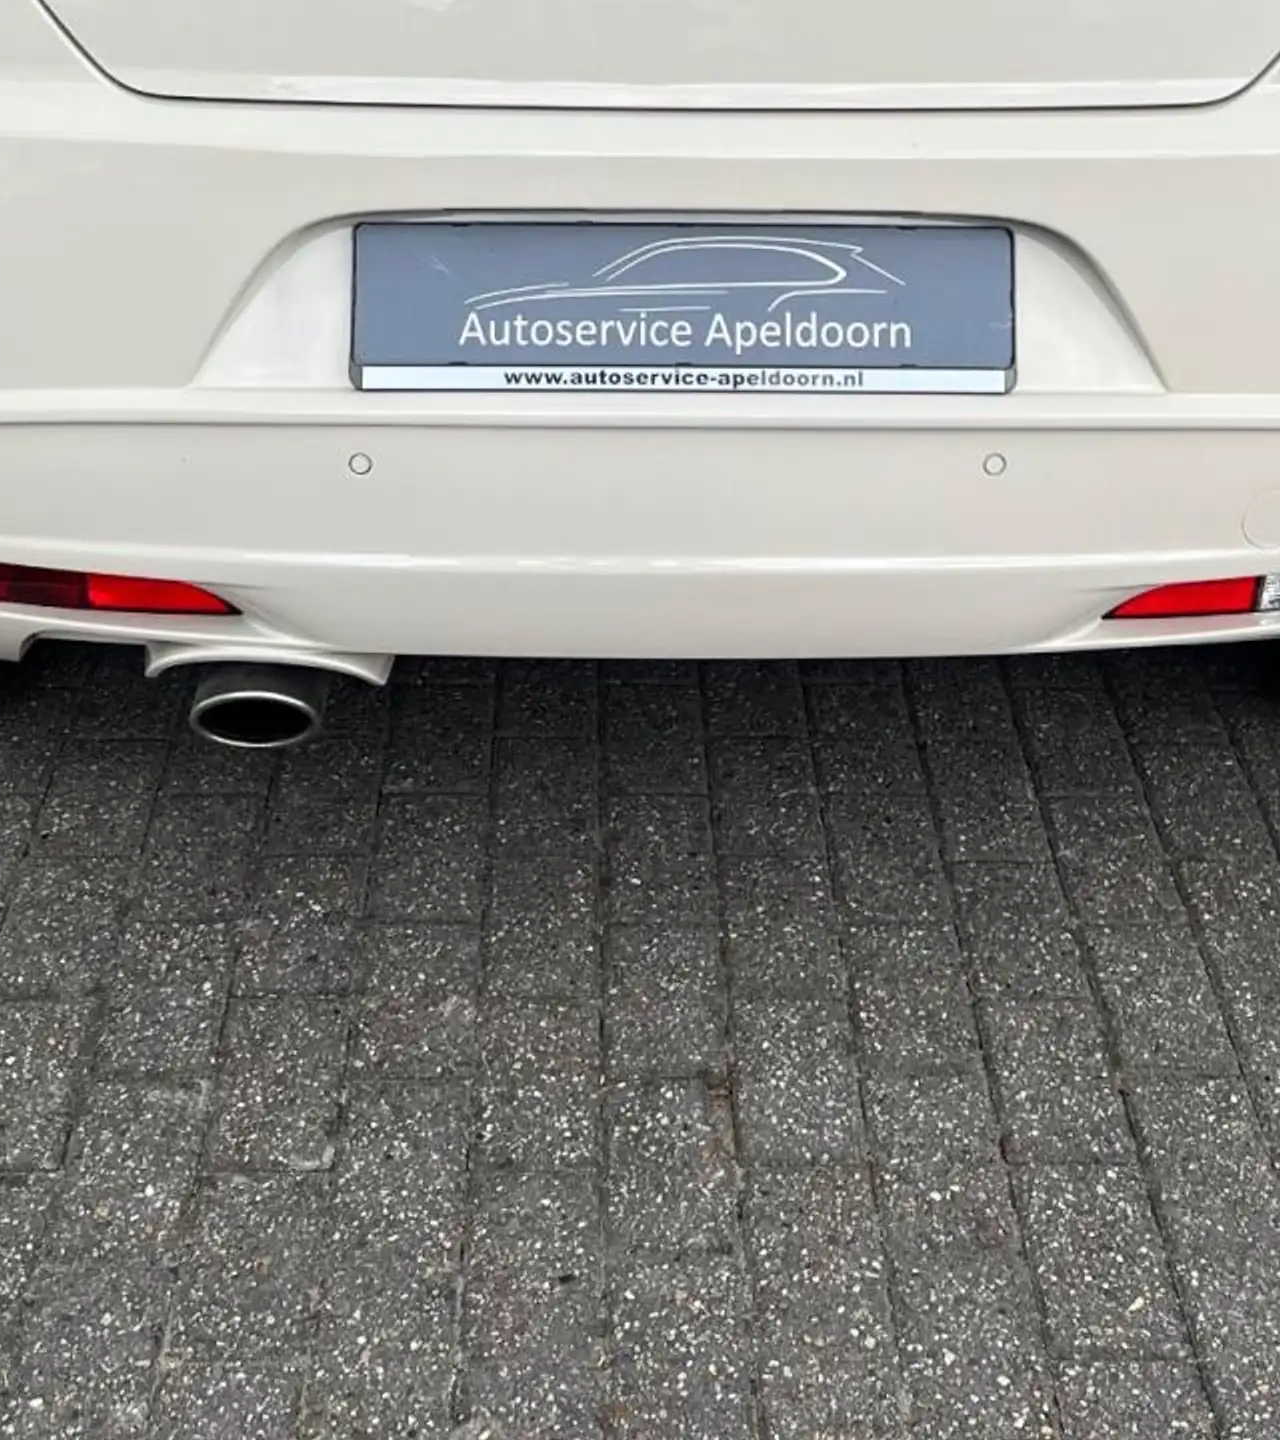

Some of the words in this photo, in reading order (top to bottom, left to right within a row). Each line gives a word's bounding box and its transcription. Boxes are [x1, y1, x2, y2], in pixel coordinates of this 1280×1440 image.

[458, 310, 693, 347] Autoservice
[703, 311, 912, 356] Apeldoorn
[503, 369, 864, 389] www.autoservice-apeldoorn.nl
